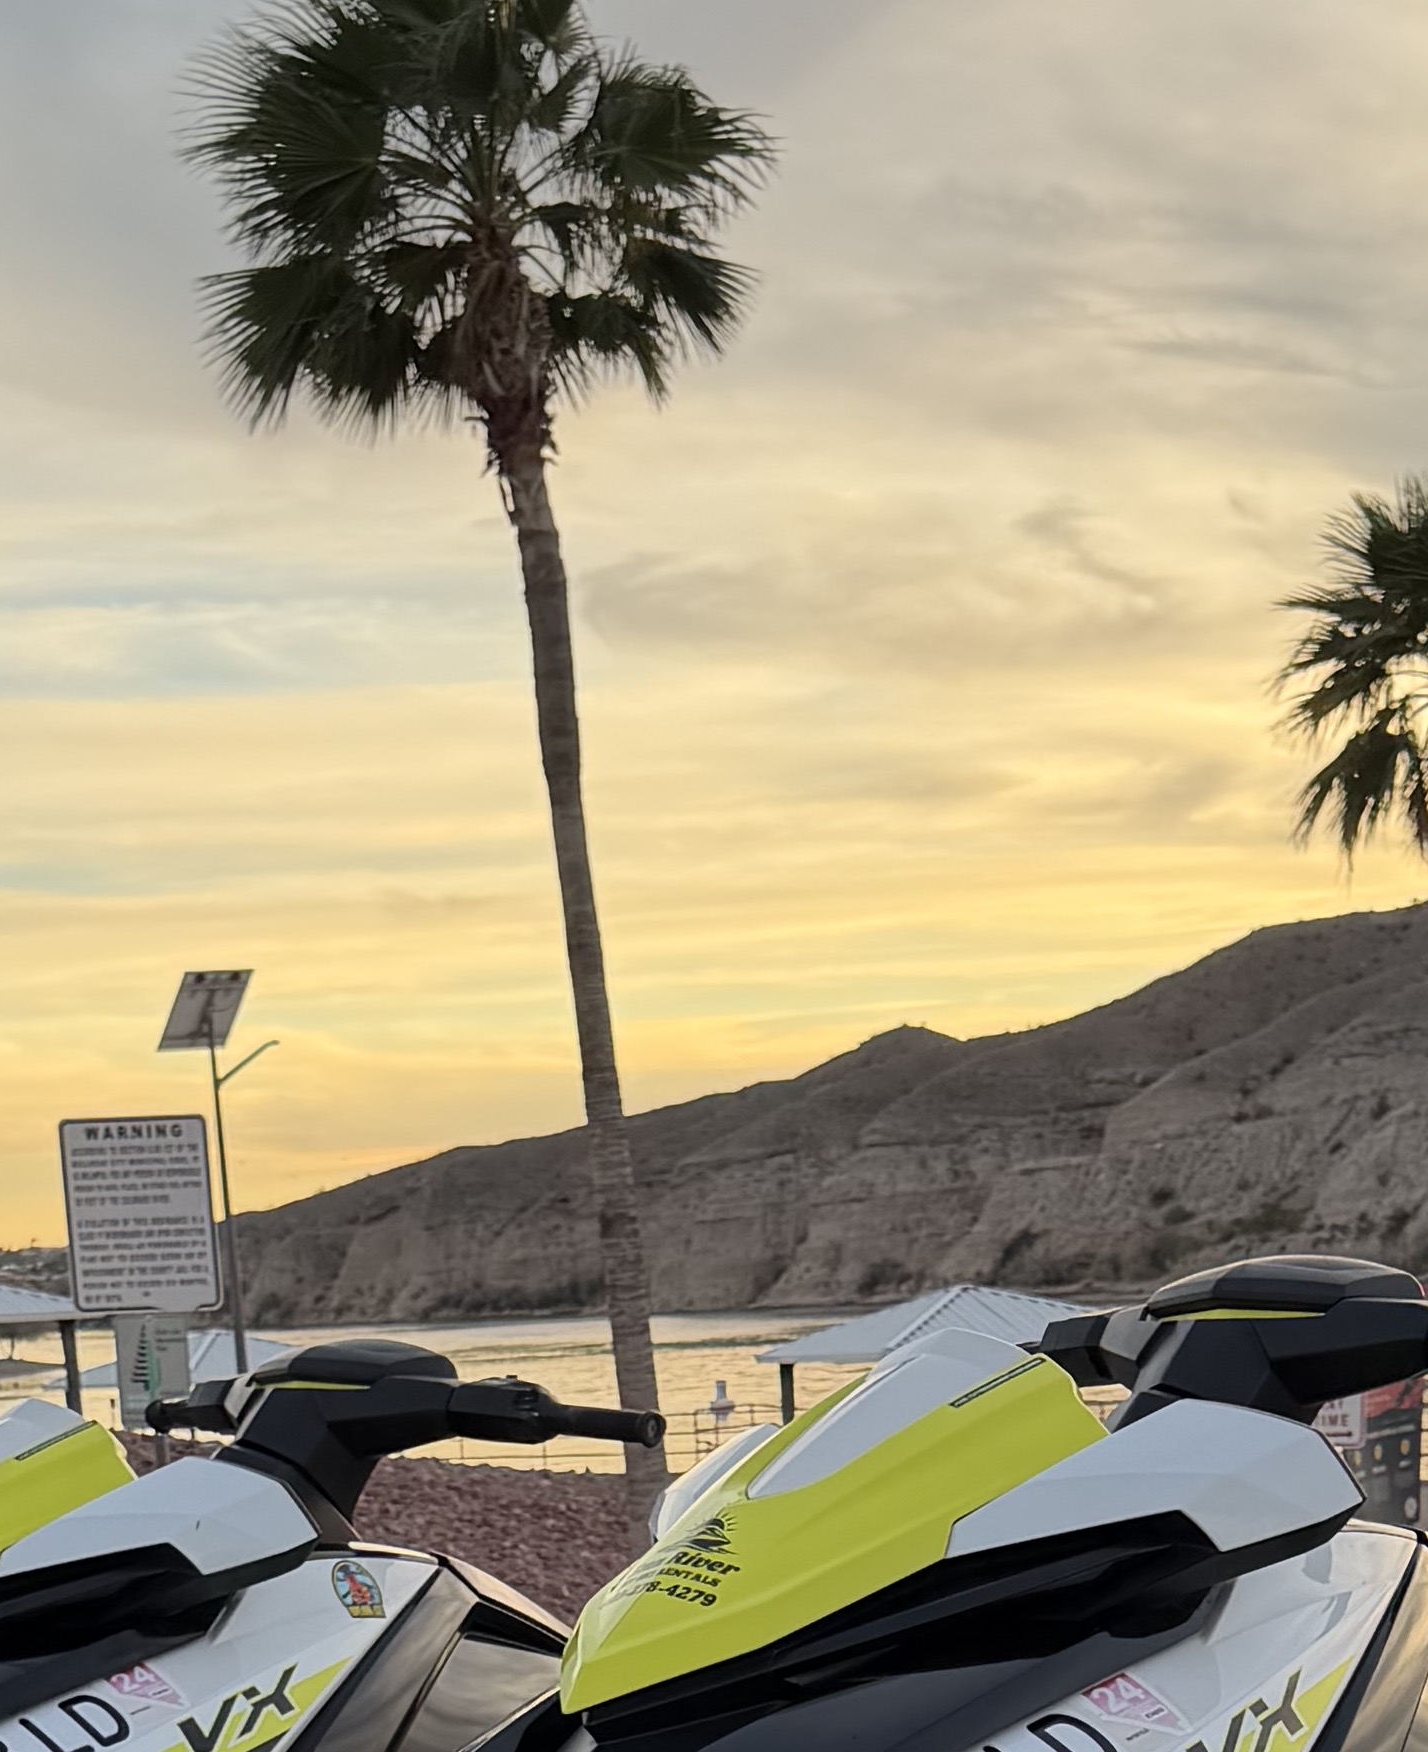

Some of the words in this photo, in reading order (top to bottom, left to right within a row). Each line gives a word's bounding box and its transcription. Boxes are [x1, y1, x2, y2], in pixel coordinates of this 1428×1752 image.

[84, 1124, 183, 1141] WARNING
[668, 1551, 741, 1575] River
[110, 1666, 157, 1693] 24
[1091, 1677, 1147, 1714] 24
